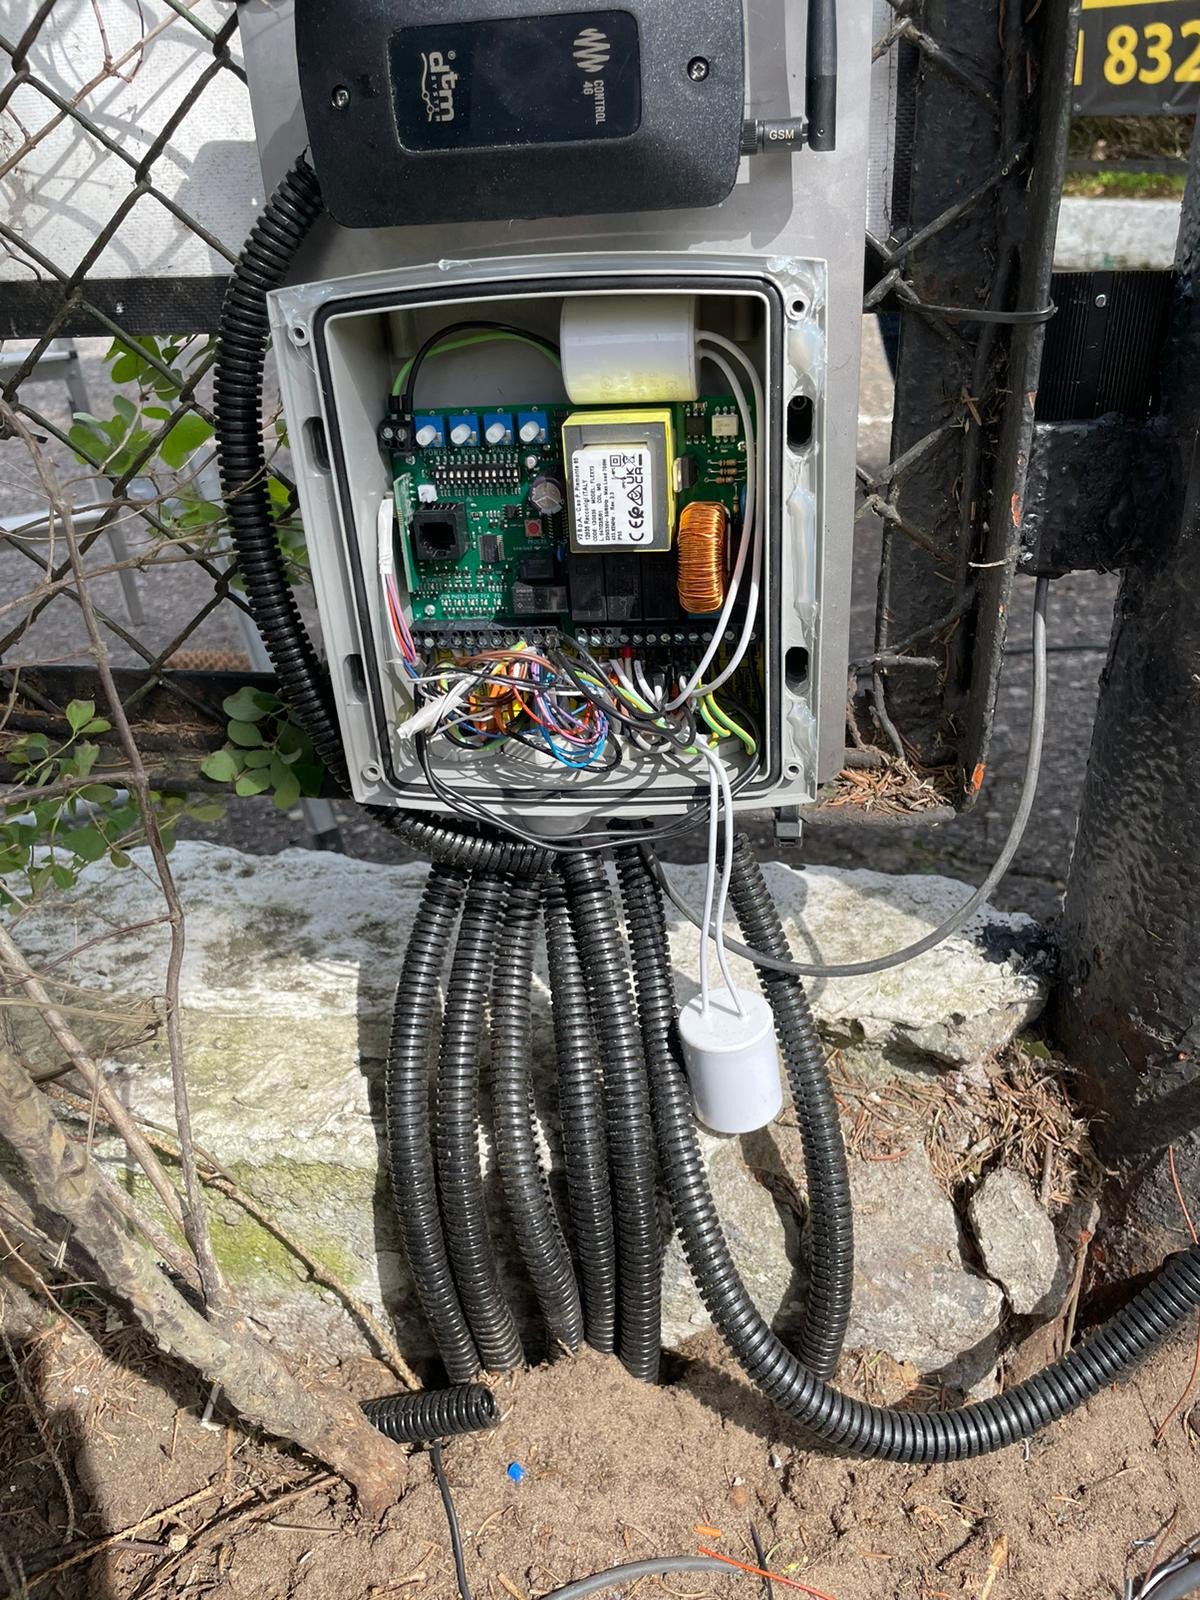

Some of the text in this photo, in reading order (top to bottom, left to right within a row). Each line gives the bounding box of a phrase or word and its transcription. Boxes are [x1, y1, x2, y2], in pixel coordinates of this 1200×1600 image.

[1103, 19, 1200, 85] 832
[429, 52, 458, 121] dtm
[431, 75, 441, 122] SYSTEM
[584, 81, 594, 95] 4G
[594, 80, 606, 125] CONTROL
[769, 129, 795, 140] GSM
[626, 467, 634, 484] UK
[637, 467, 643, 483] CA
